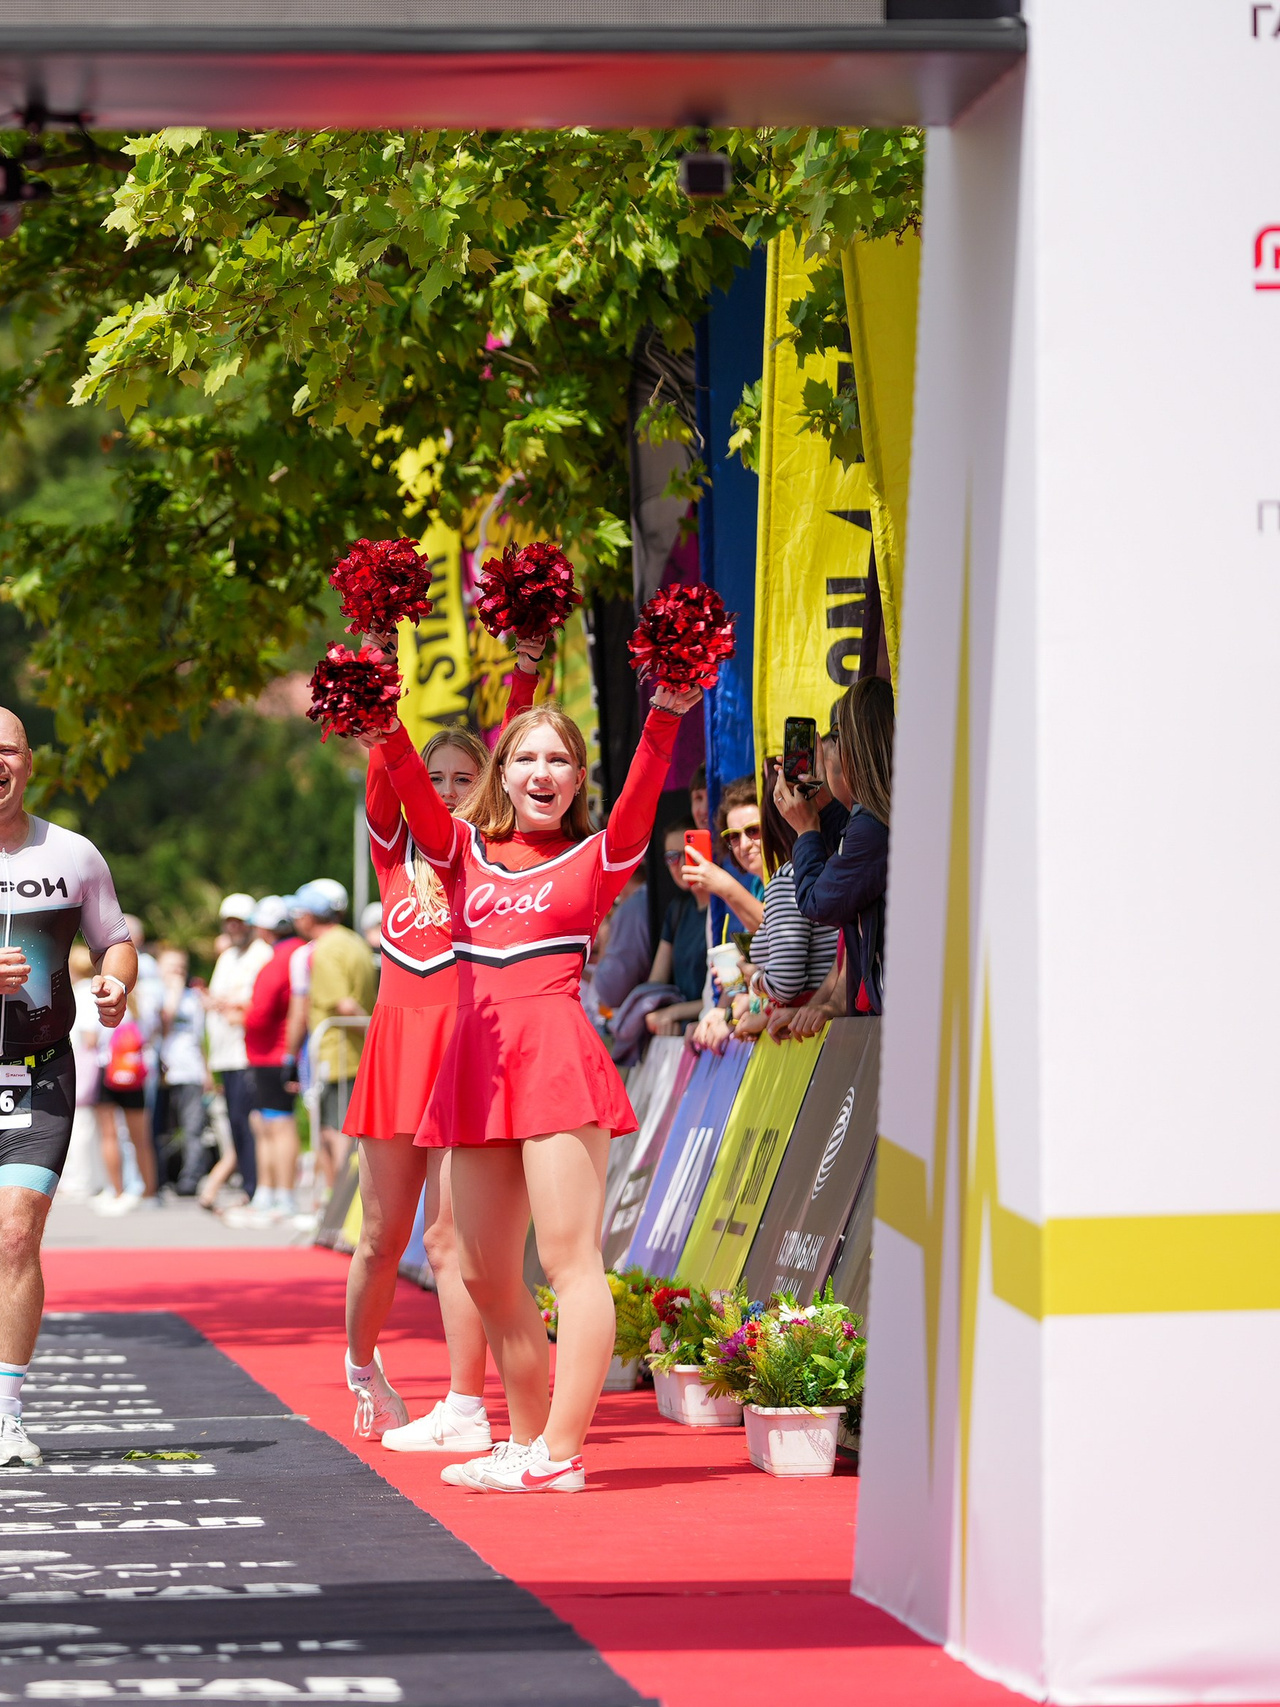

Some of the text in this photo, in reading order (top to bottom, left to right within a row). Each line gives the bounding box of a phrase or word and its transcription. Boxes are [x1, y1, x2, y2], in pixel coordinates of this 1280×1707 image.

[387, 886, 451, 938] Coo
[463, 881, 553, 928] Cool
[7, 1583, 321, 1600] STAR
[24, 1677, 399, 1698] STAR
